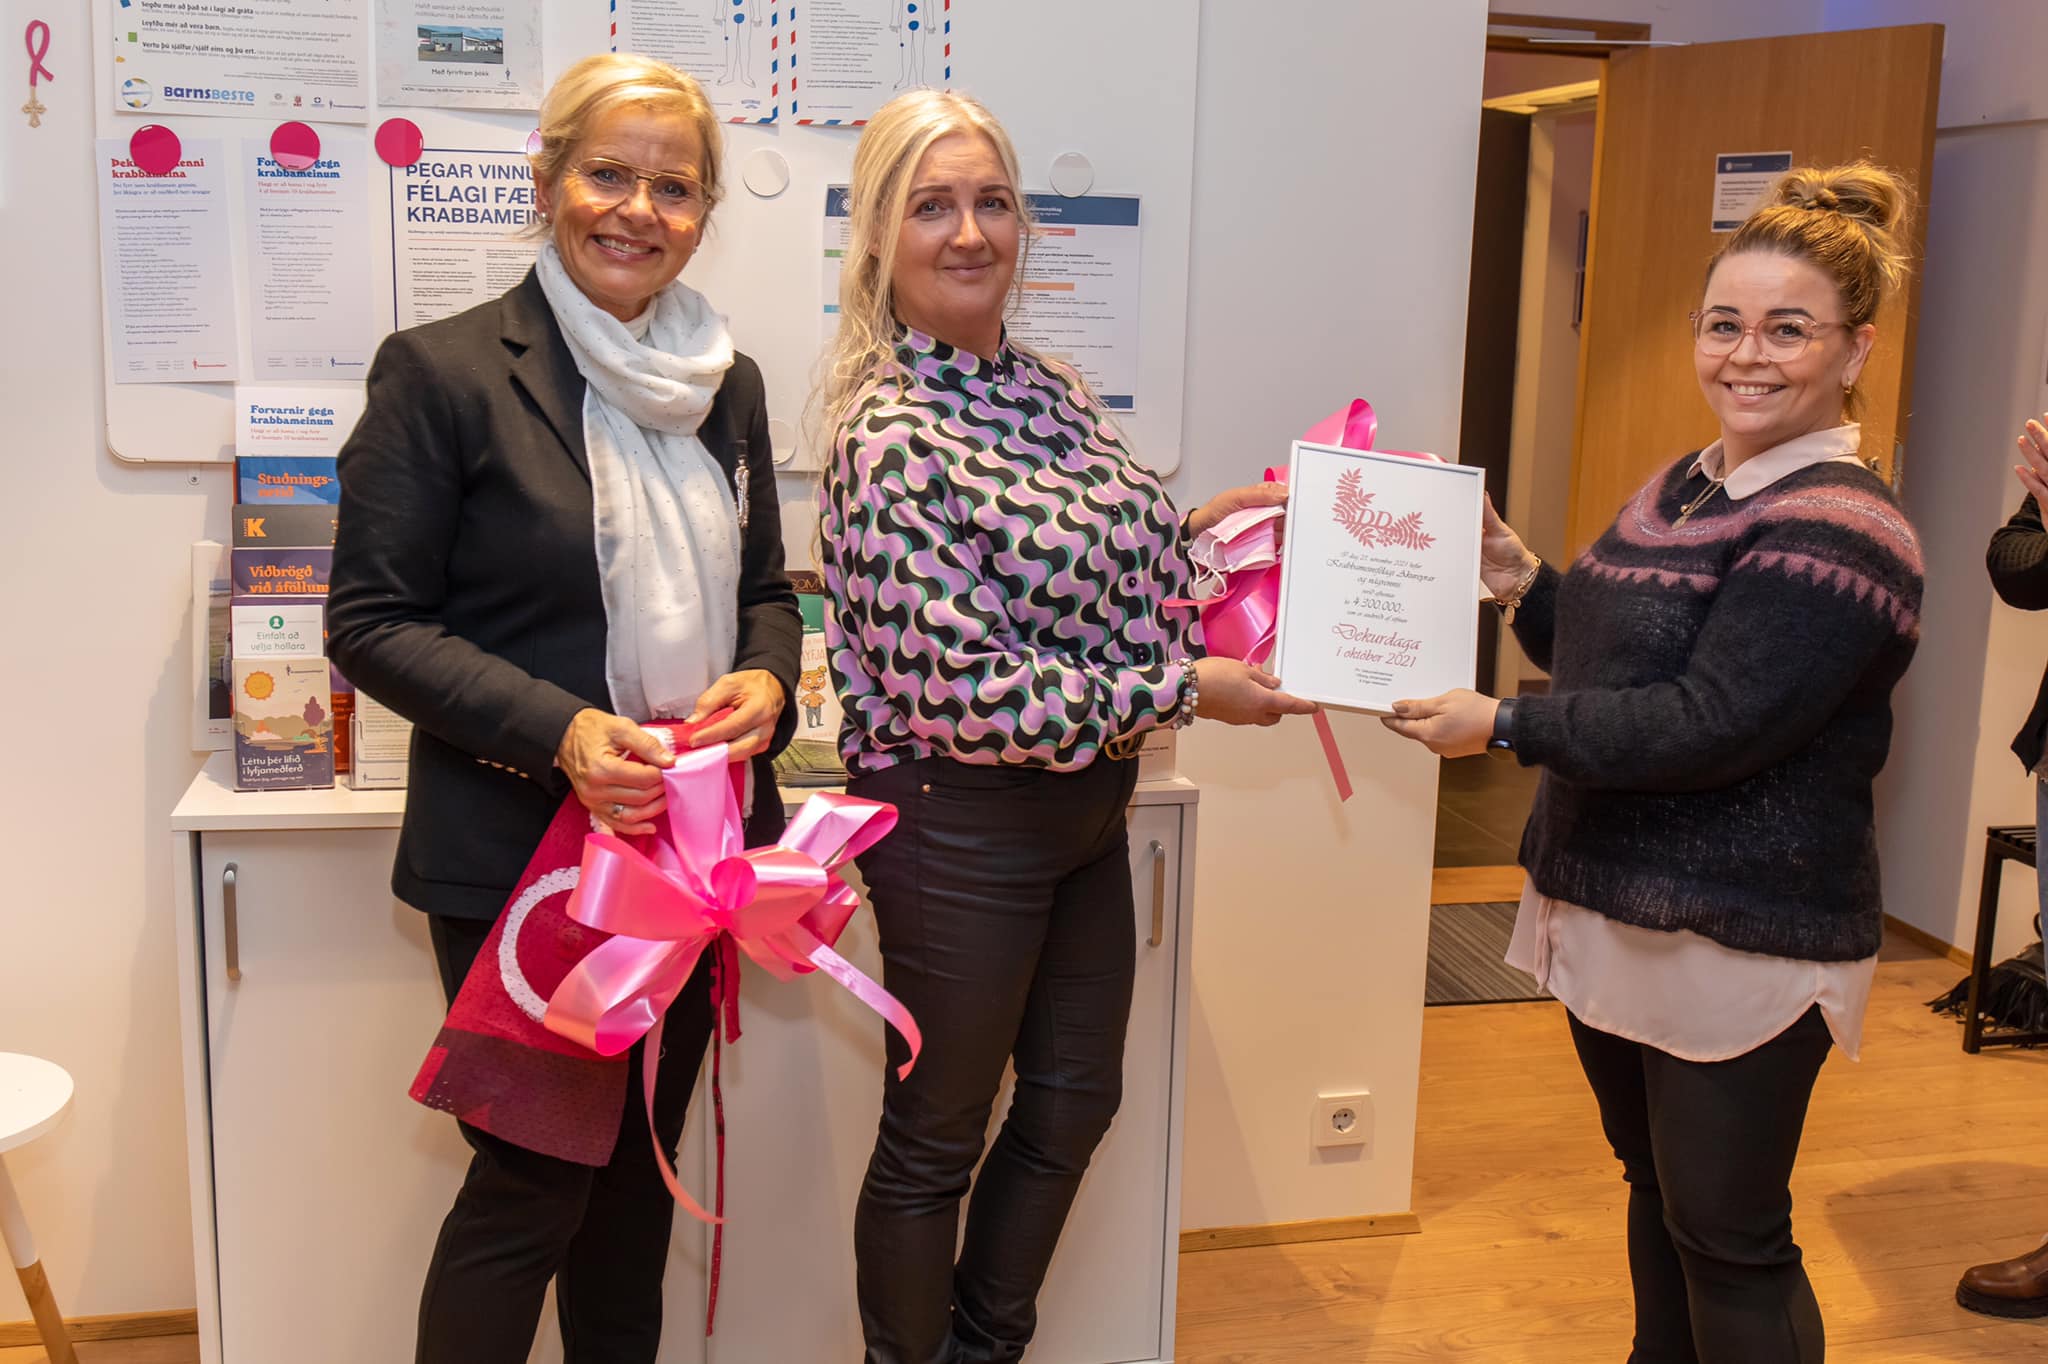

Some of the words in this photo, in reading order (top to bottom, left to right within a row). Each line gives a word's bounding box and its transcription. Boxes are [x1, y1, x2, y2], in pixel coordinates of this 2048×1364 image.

[257, 168, 340, 178] krabbameinum
[406, 162, 473, 178] ÞEGAR
[407, 180, 487, 203] FÉLAGI
[250, 405, 304, 415] Forvarnir
[308, 408, 335, 416] gegn
[250, 416, 334, 425] krabbameinum
[258, 472, 335, 488] Stuðnings-
[247, 518, 267, 537] K
[248, 564, 313, 580] Viðbrögð
[250, 582, 272, 593] við
[275, 581, 329, 593] áföllum
[257, 632, 286, 640] Einfalt
[1332, 622, 1422, 654] Dekurdaga
[1344, 647, 1384, 662] október
[1385, 652, 1416, 667] 2021
[242, 757, 266, 766] Léttu
[267, 756, 281, 766] þér
[247, 764, 303, 776] lyfjameðferð
